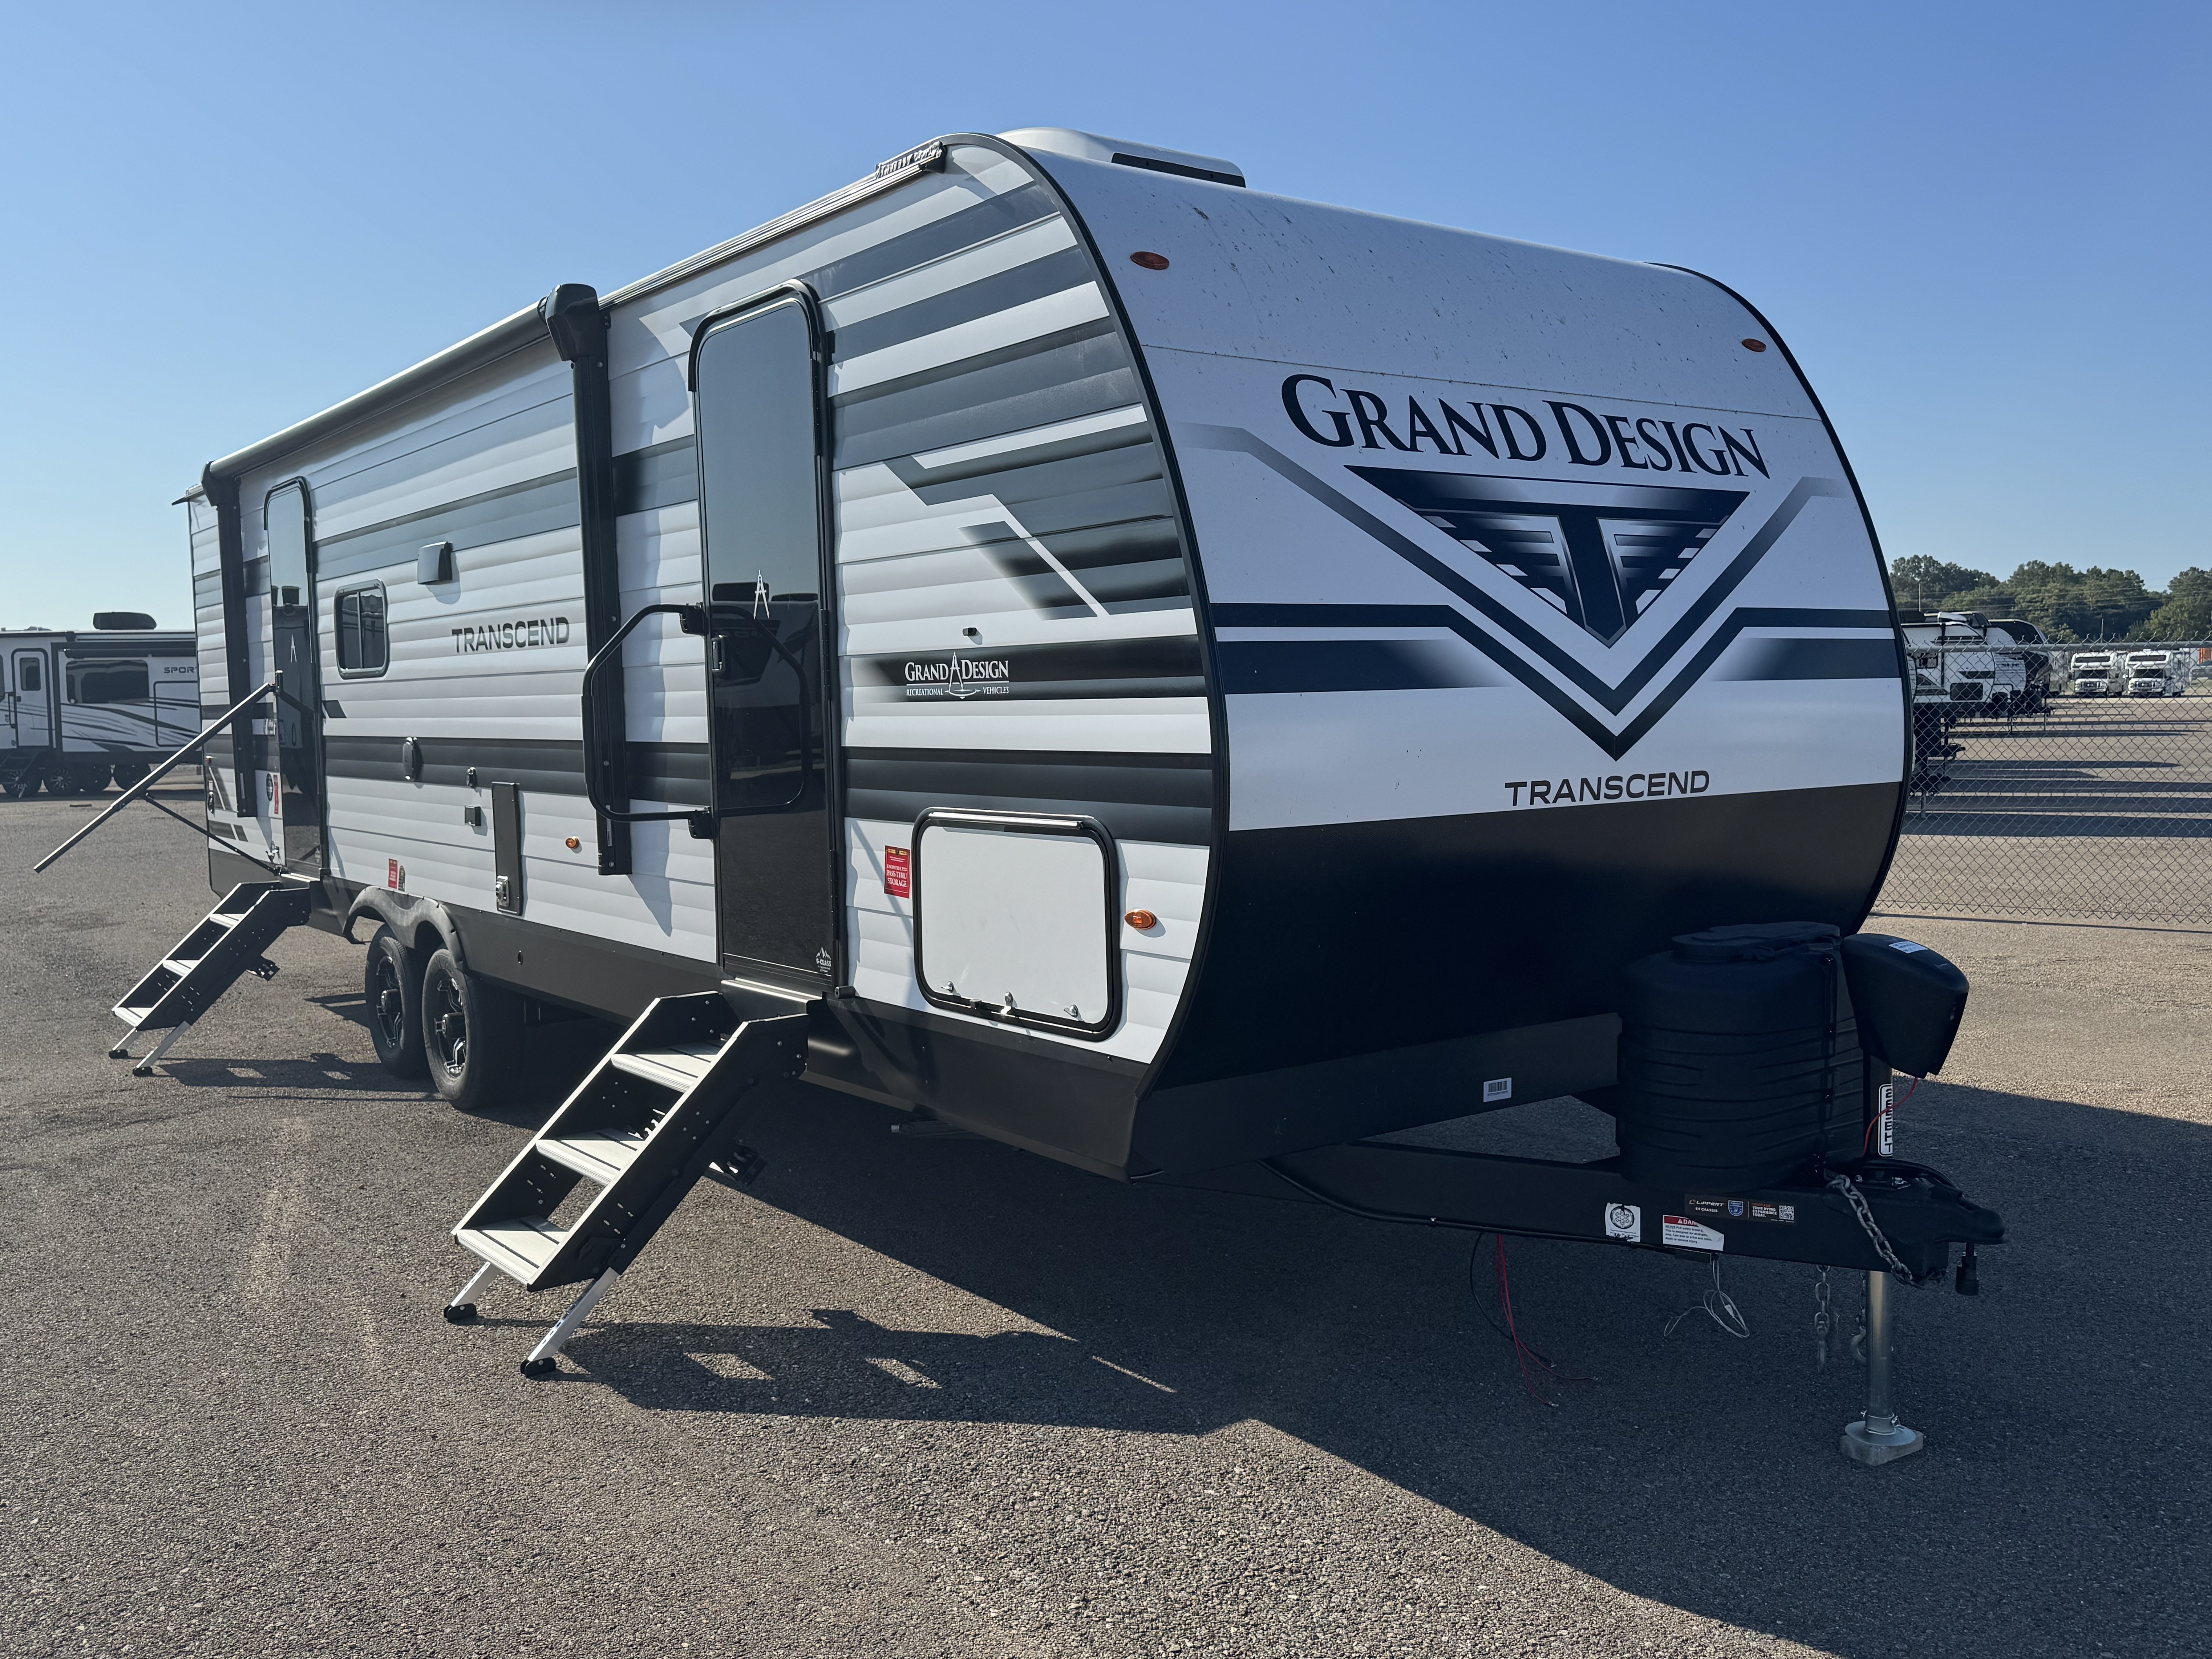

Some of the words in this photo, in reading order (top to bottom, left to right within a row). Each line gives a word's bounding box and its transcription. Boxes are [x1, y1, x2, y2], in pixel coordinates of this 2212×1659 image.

[1281, 374, 1547, 462] GRAND
[1542, 400, 1770, 479] DESIGN
[452, 617, 570, 653] TRANSCEND
[905, 662, 949, 681] GRAND
[960, 659, 1009, 679] DESIGN
[906, 688, 943, 696] RECREATIONAL
[983, 686, 1009, 694] VEHICLES
[1504, 770, 1709, 806] TRANSCEND
[887, 878, 907, 887] STORAGE
